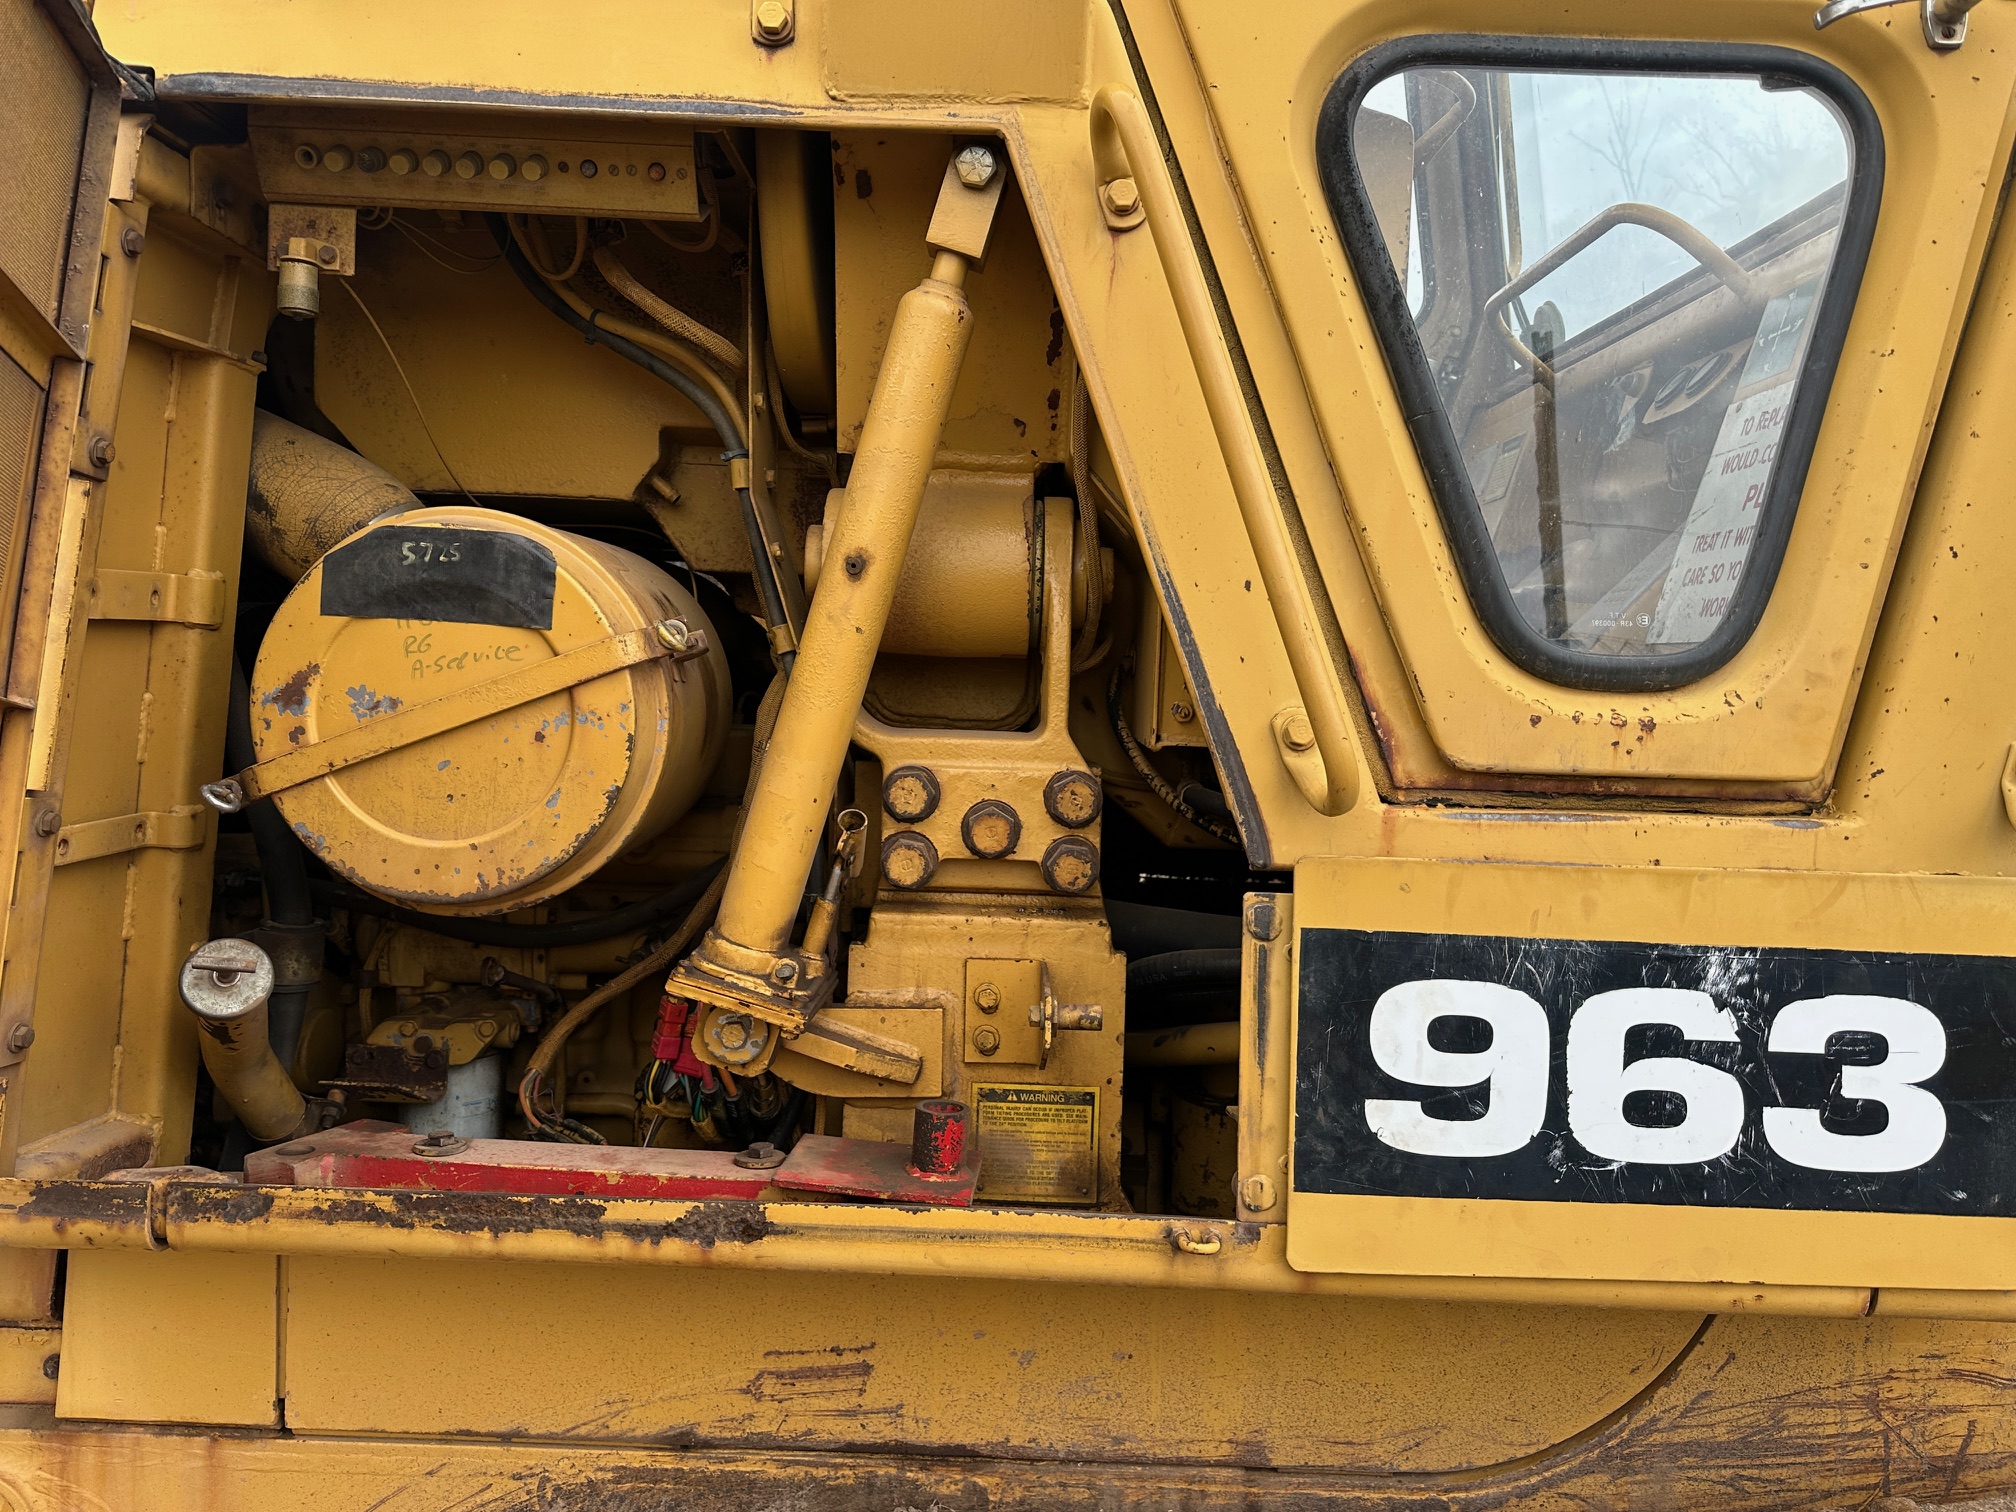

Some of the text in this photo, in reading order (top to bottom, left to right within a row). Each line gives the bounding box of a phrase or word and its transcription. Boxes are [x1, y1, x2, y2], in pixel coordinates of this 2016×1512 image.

[1740, 416, 1755, 437] TO
[1721, 447, 1759, 476] WOULD
[1691, 530, 1719, 554] TREAT
[1720, 530, 1731, 550] IT
[1682, 565, 1707, 588] CARE
[1708, 562, 1725, 584] SO
[1364, 979, 1947, 1172] 963
[1020, 1093, 1065, 1102] WARNING
